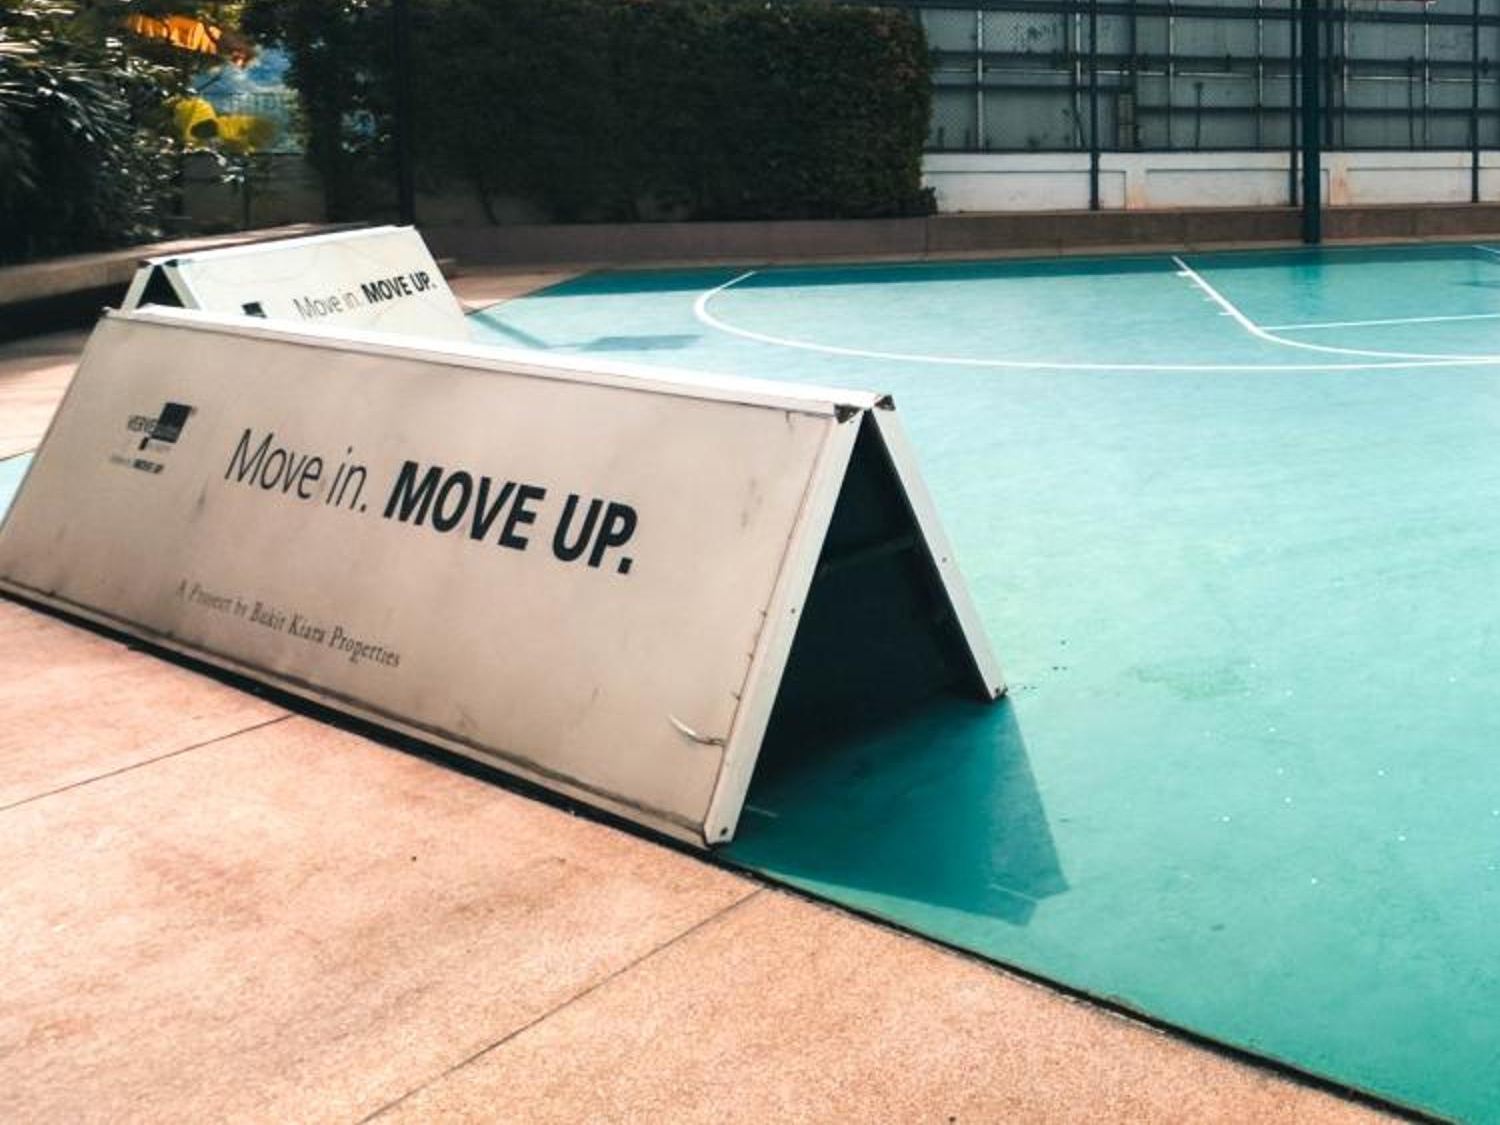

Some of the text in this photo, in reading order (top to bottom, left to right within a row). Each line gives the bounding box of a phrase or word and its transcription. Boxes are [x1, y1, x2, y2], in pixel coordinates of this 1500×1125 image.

[293, 295, 345, 321] Move
[361, 276, 412, 304] MOVE
[225, 428, 640, 575] Move in. MOVE UP.
[328, 625, 401, 668] Properties
